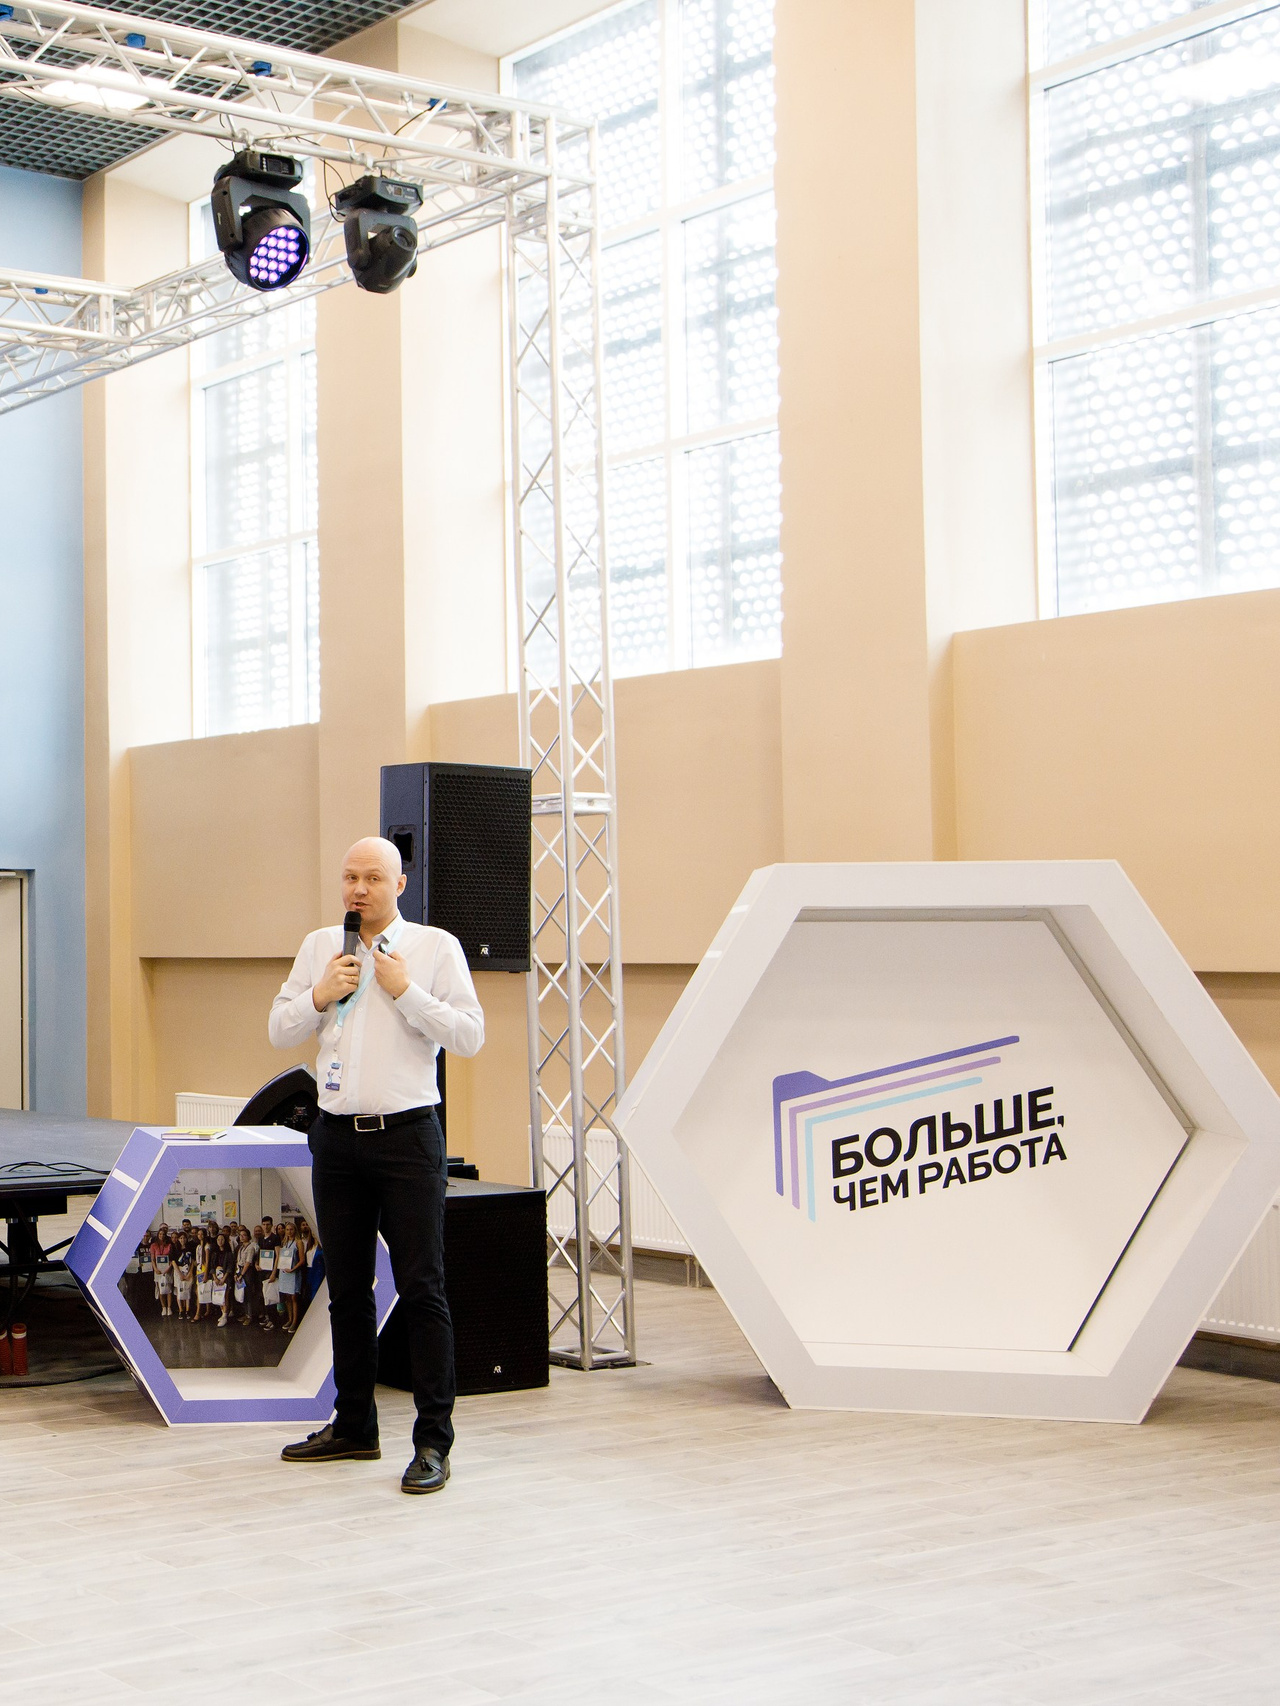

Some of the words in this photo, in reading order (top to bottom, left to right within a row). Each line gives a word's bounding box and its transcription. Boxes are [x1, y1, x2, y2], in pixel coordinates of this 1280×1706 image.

[831, 1086, 1065, 1179] БОЛЬШЕ,
[833, 1168, 910, 1211] ЧЕМ
[918, 1132, 1068, 1195] РАБОТА
